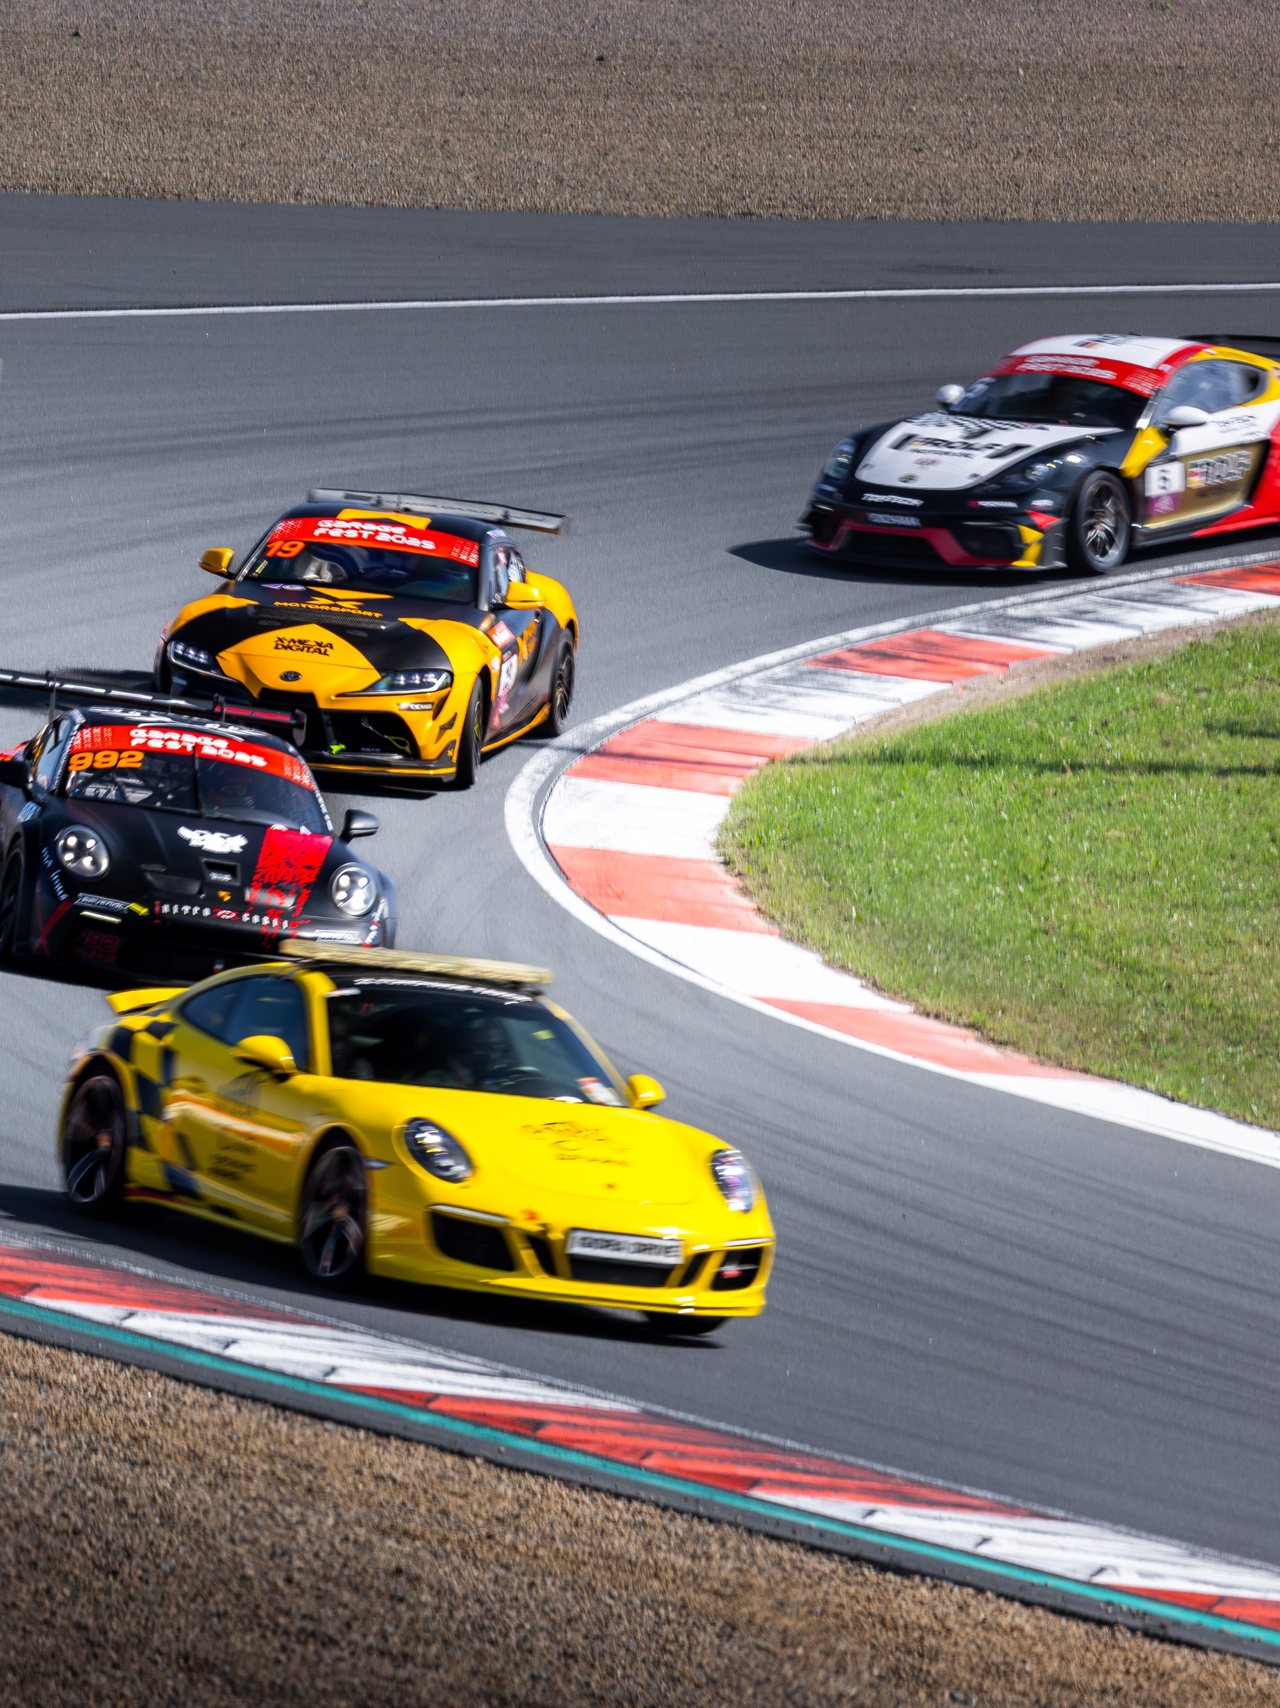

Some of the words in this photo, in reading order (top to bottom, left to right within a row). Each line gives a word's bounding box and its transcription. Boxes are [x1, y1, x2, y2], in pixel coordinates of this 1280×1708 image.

[265, 540, 306, 558] 19
[375, 532, 435, 550] 2025
[274, 601, 384, 619] MOTORSPORT
[274, 643, 329, 656] DIGITAL
[68, 750, 145, 771] 992
[200, 745, 268, 768] 2025
